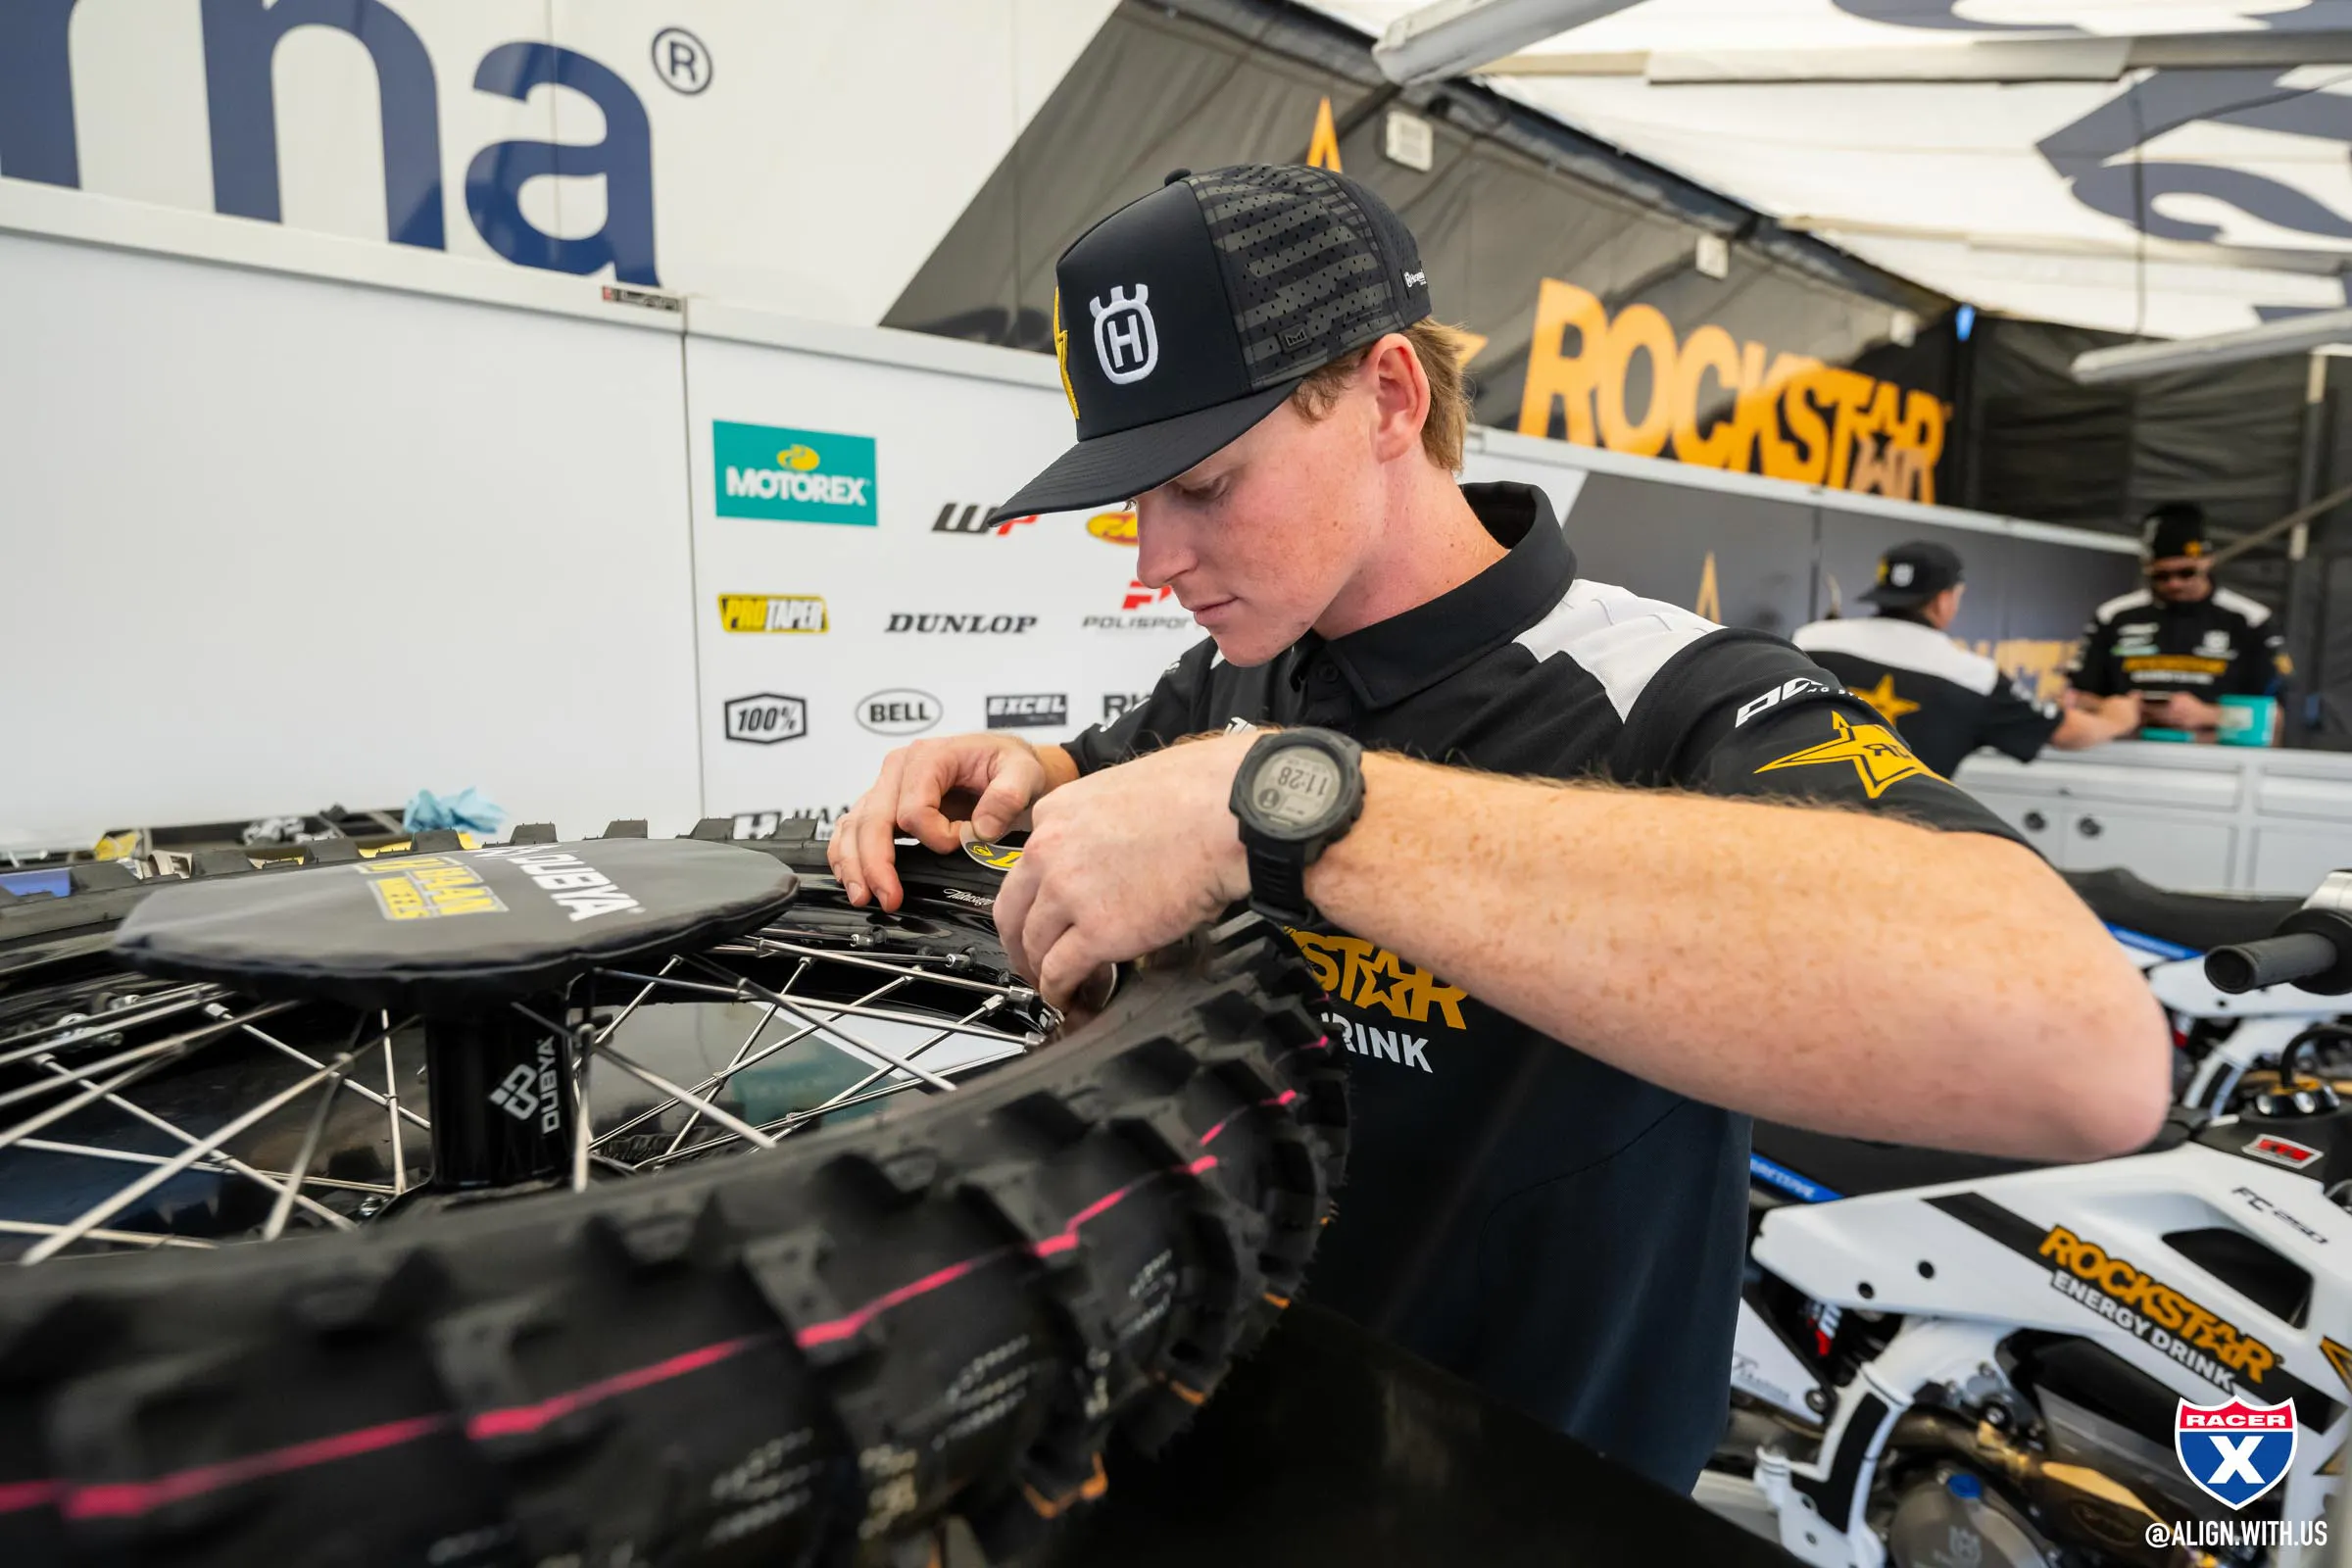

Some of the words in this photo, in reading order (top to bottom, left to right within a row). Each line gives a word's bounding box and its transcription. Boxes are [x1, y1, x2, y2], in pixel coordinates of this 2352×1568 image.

[1518, 276, 1946, 506] ROCKSTAR
[725, 466, 868, 506] MOTOREX
[884, 613, 1037, 634] DUNLOP
[738, 706, 797, 732] 100%
[869, 703, 931, 723] BELL
[987, 696, 1066, 717] EXCEL
[1278, 766, 1328, 796] 11:28
[506, 852, 640, 922] DUBYA
[1321, 1012, 1434, 1074] RINK
[537, 1036, 561, 1135] DUBYA
[2231, 1186, 2275, 1212] FC
[2037, 1224, 2276, 1385] ROCKSTAR
[2053, 1267, 2153, 1342] ENERGY
[2150, 1329, 2237, 1393] DRINK
